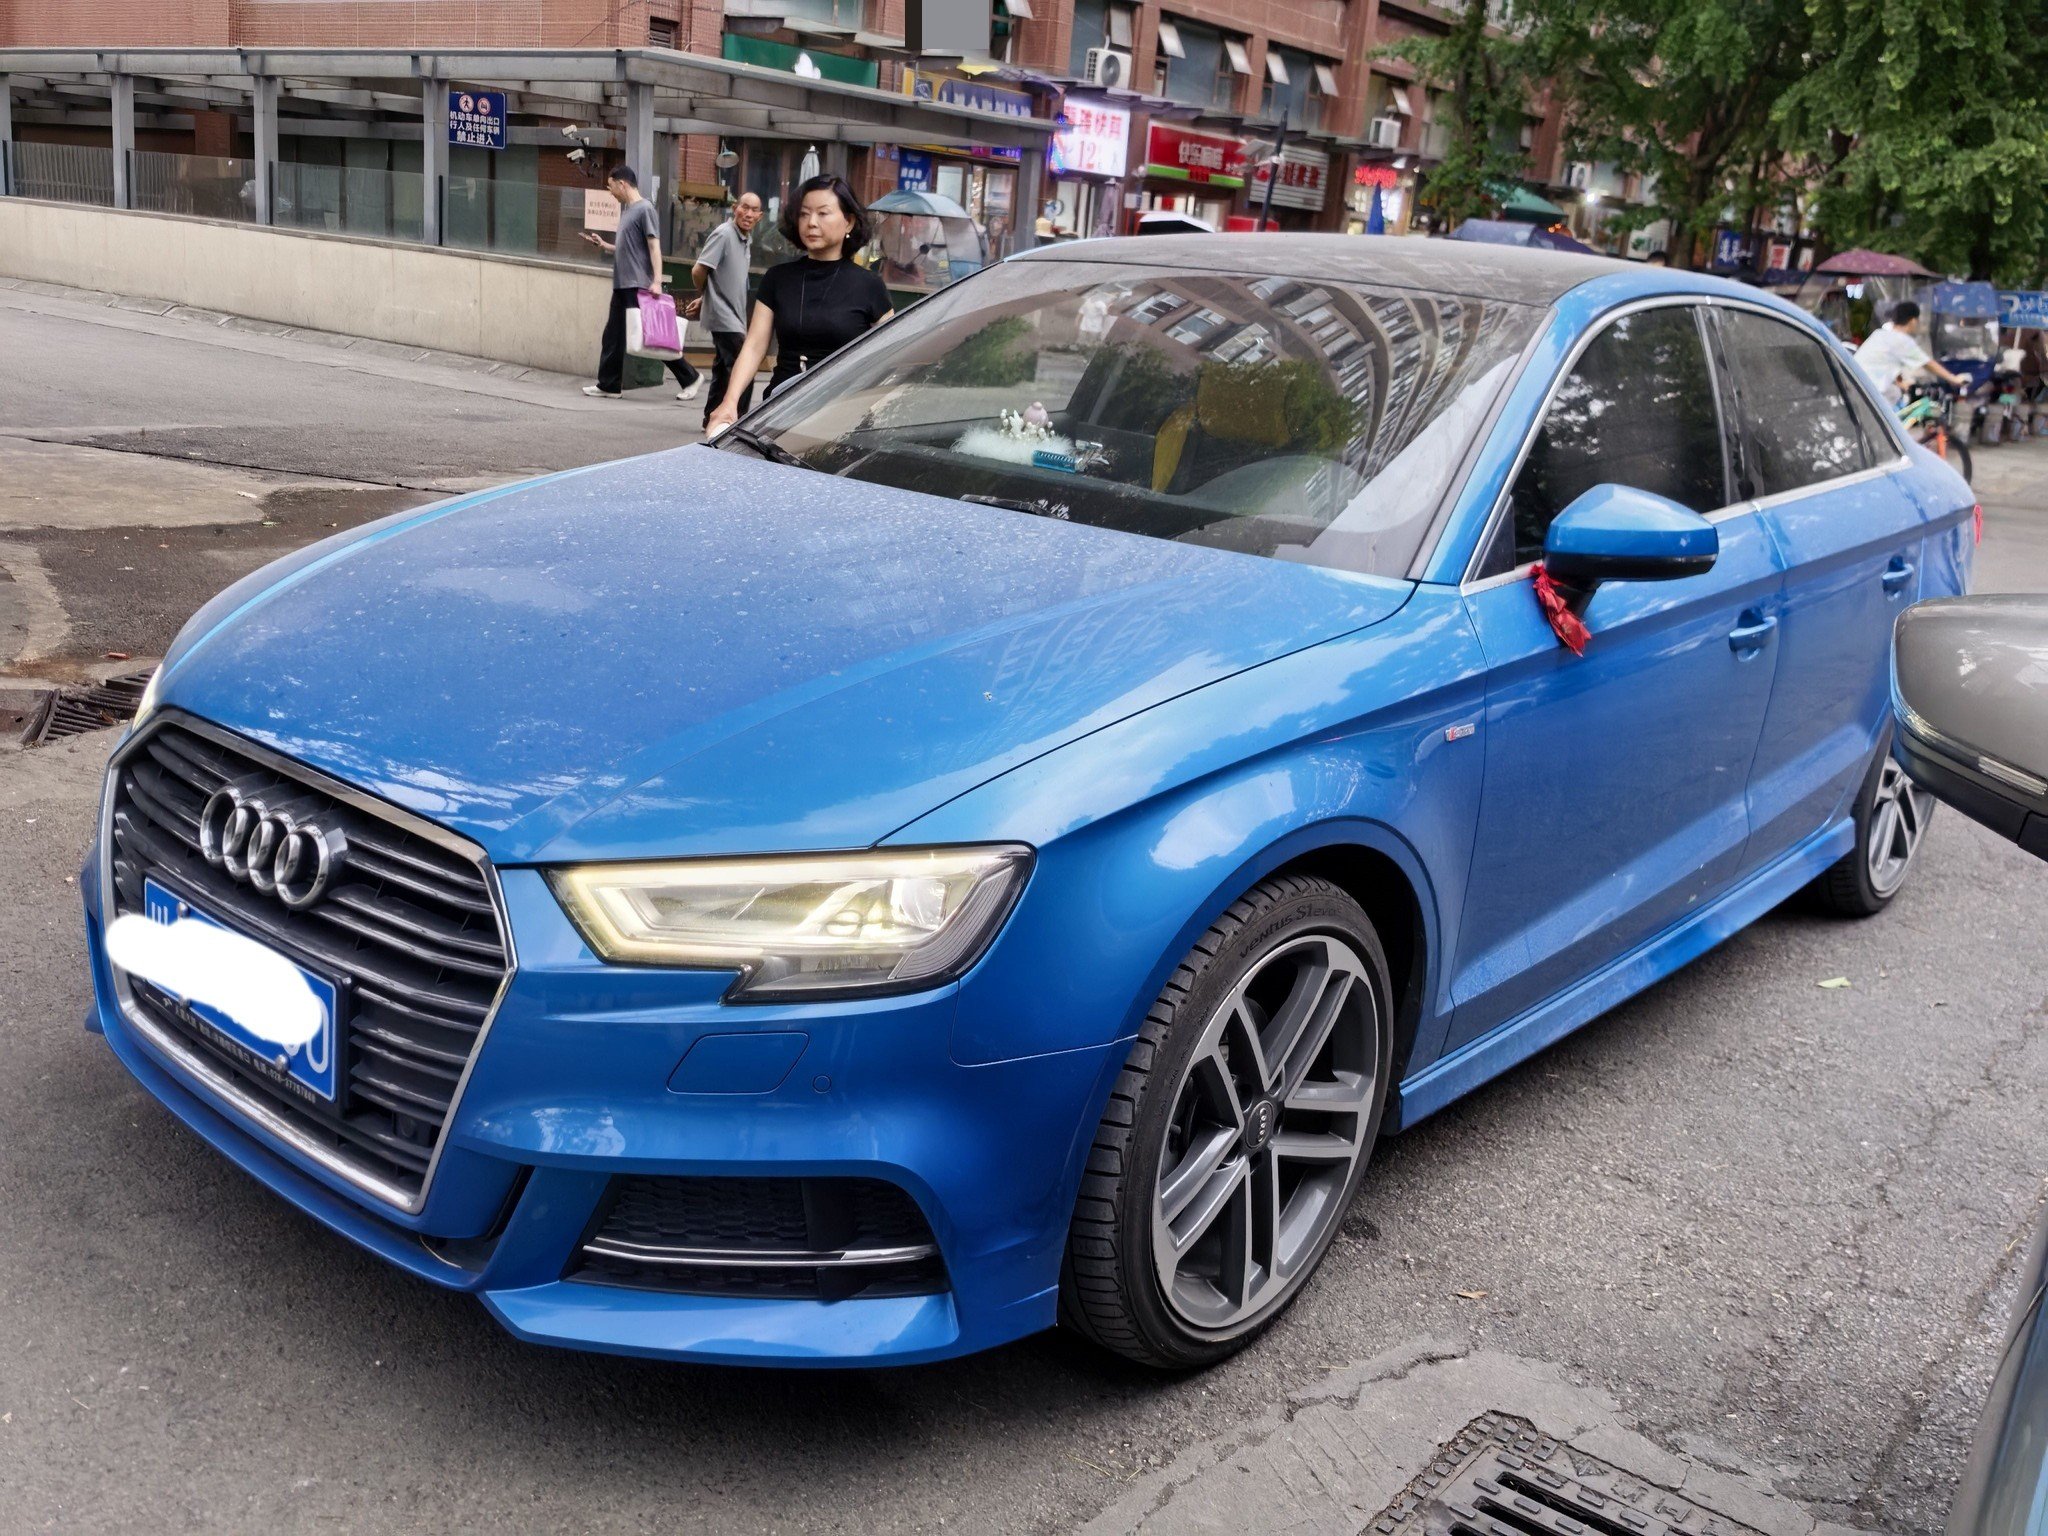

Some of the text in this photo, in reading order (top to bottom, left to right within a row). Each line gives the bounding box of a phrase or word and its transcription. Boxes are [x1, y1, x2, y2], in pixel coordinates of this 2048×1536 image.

[449, 110, 500, 126] 机动车单向出口
[449, 120, 501, 135] 行人及任何车辆
[456, 130, 494, 145] 禁止进入
